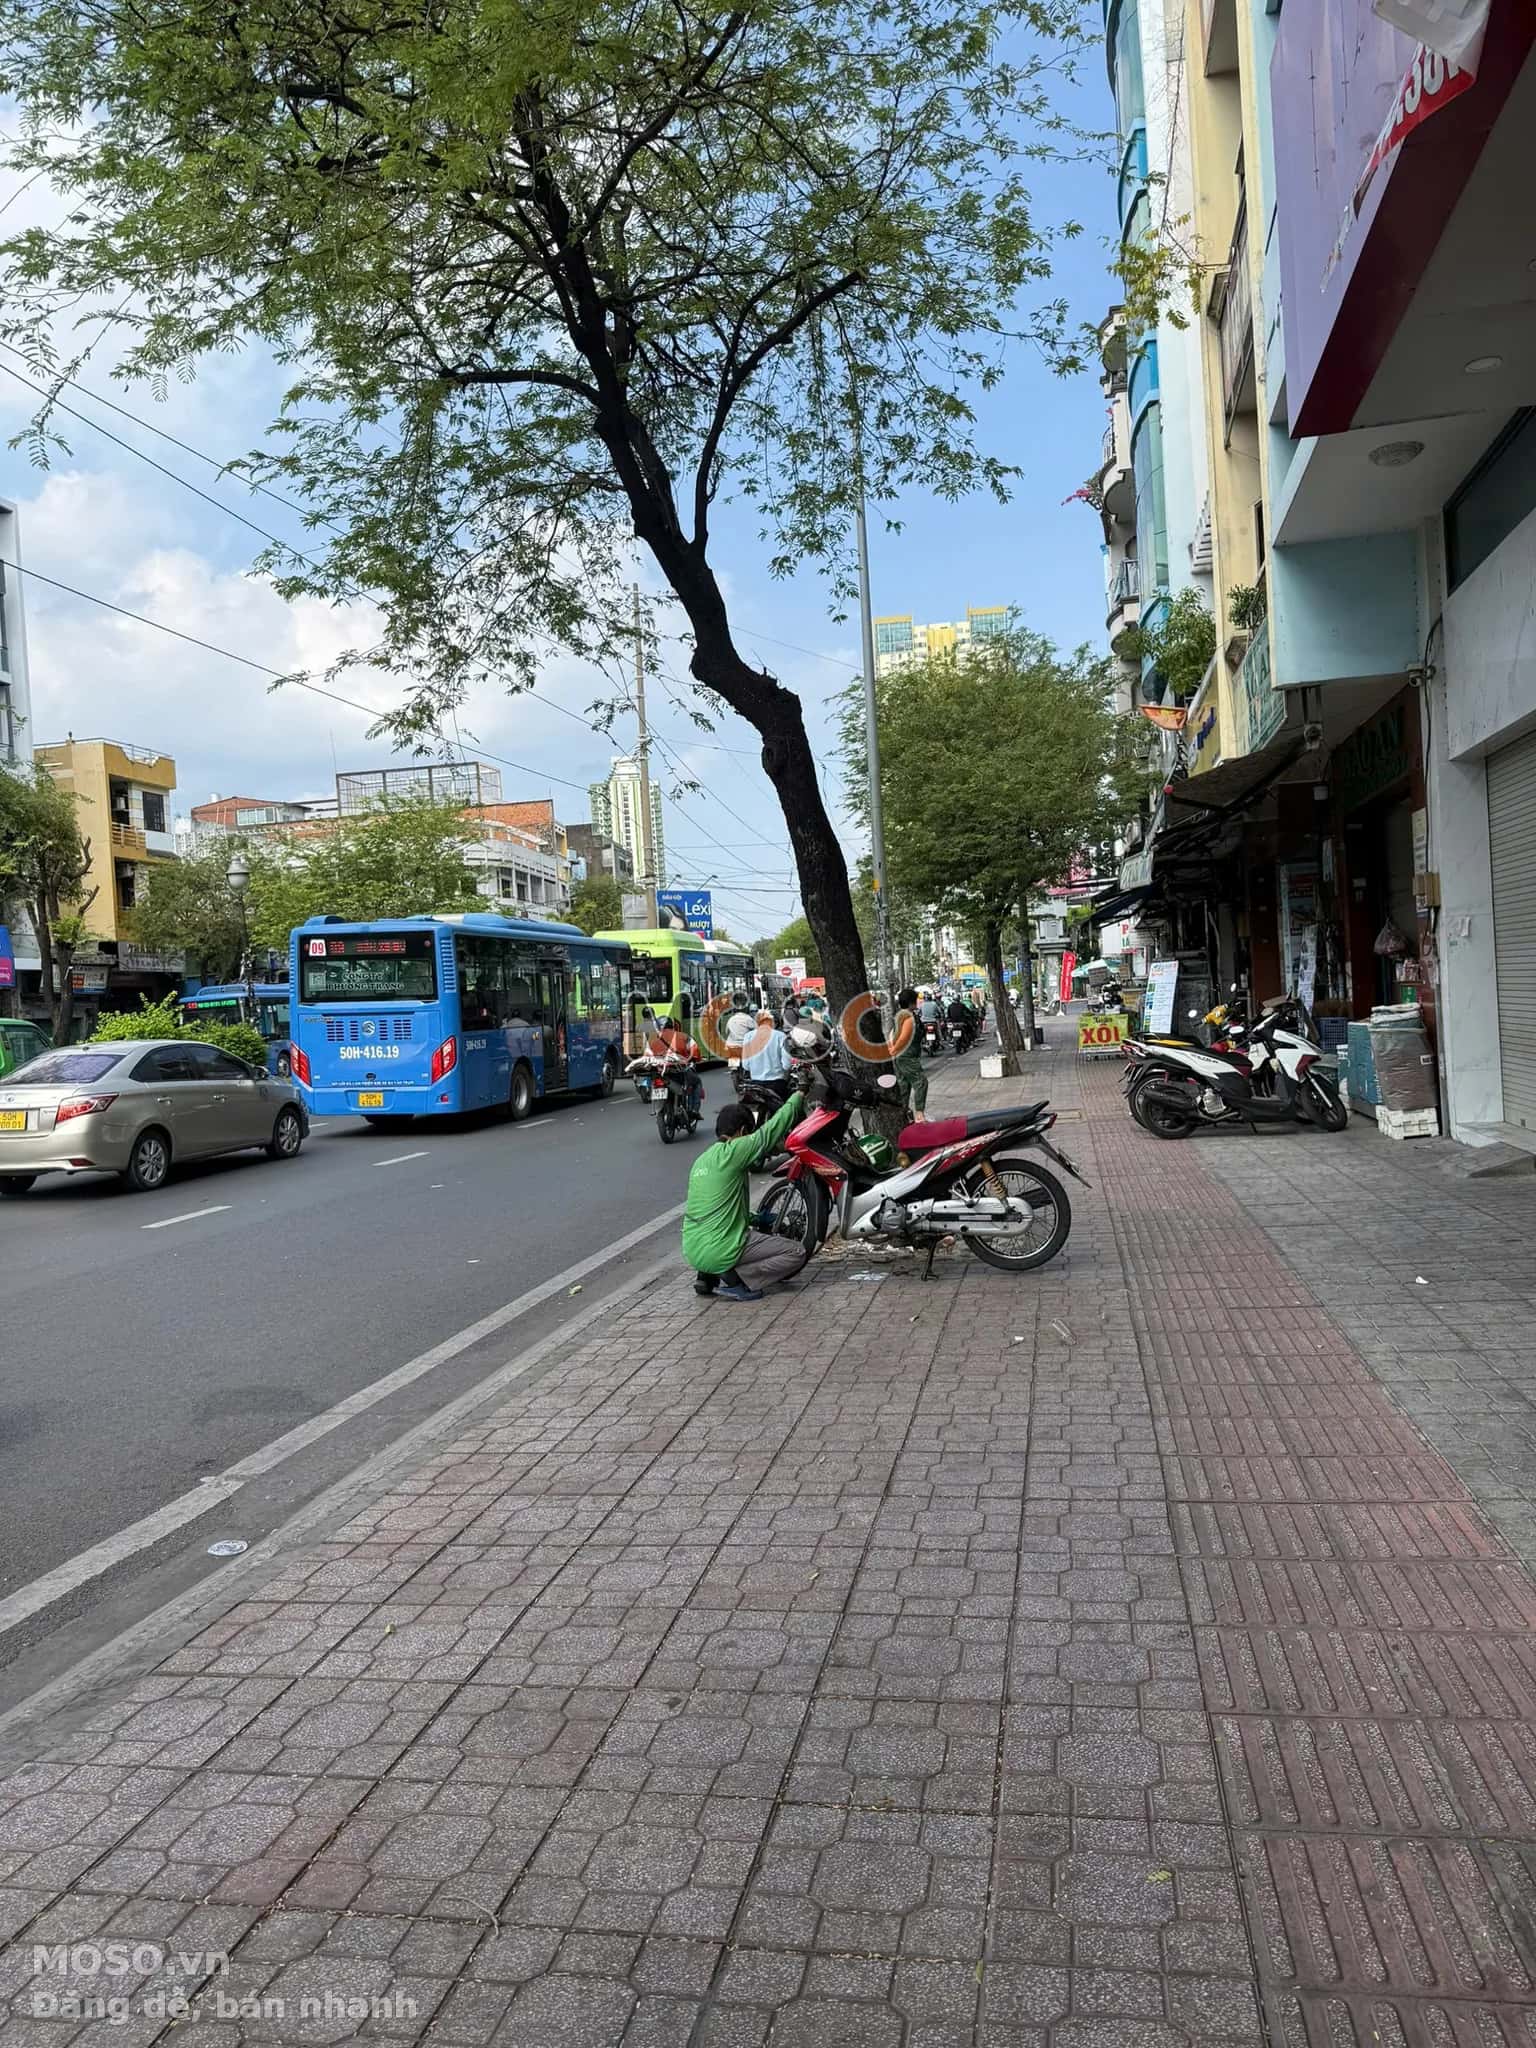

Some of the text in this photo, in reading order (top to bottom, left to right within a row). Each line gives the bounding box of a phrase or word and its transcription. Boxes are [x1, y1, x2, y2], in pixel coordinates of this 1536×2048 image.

[311, 942, 325, 954] 09
[1081, 1023, 1121, 1045] XÔI
[339, 1045, 400, 1060] 50H-416.19
